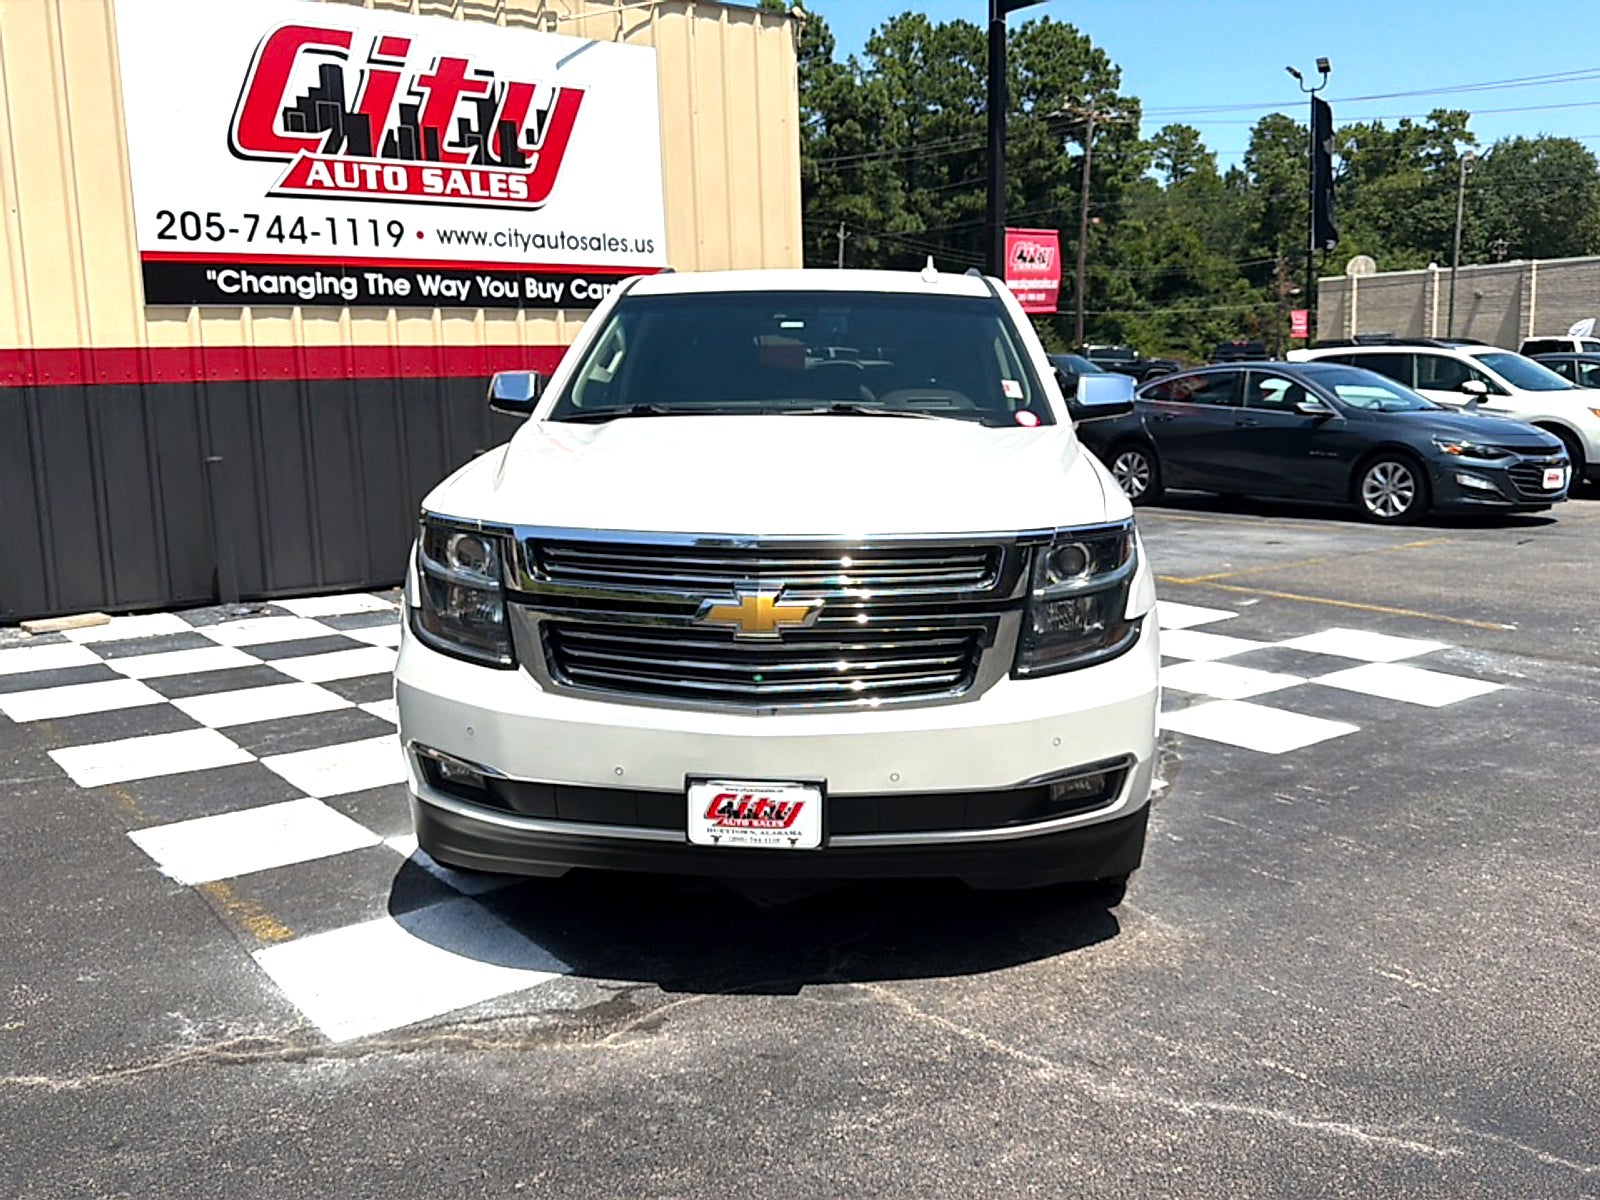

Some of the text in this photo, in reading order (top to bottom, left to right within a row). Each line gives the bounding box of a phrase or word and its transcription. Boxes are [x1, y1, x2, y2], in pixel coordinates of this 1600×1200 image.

[229, 24, 587, 205] City
[305, 160, 529, 200] AUTO SALES
[156, 209, 655, 253] 205-744-1119 www.cityautosales.us
[206, 268, 358, 300] "Changing
[364, 272, 411, 297] The
[416, 274, 472, 302] Way
[475, 275, 521, 299] You
[525, 277, 568, 303] Buy
[704, 793, 805, 828] City
[721, 818, 750, 827] AUTO
